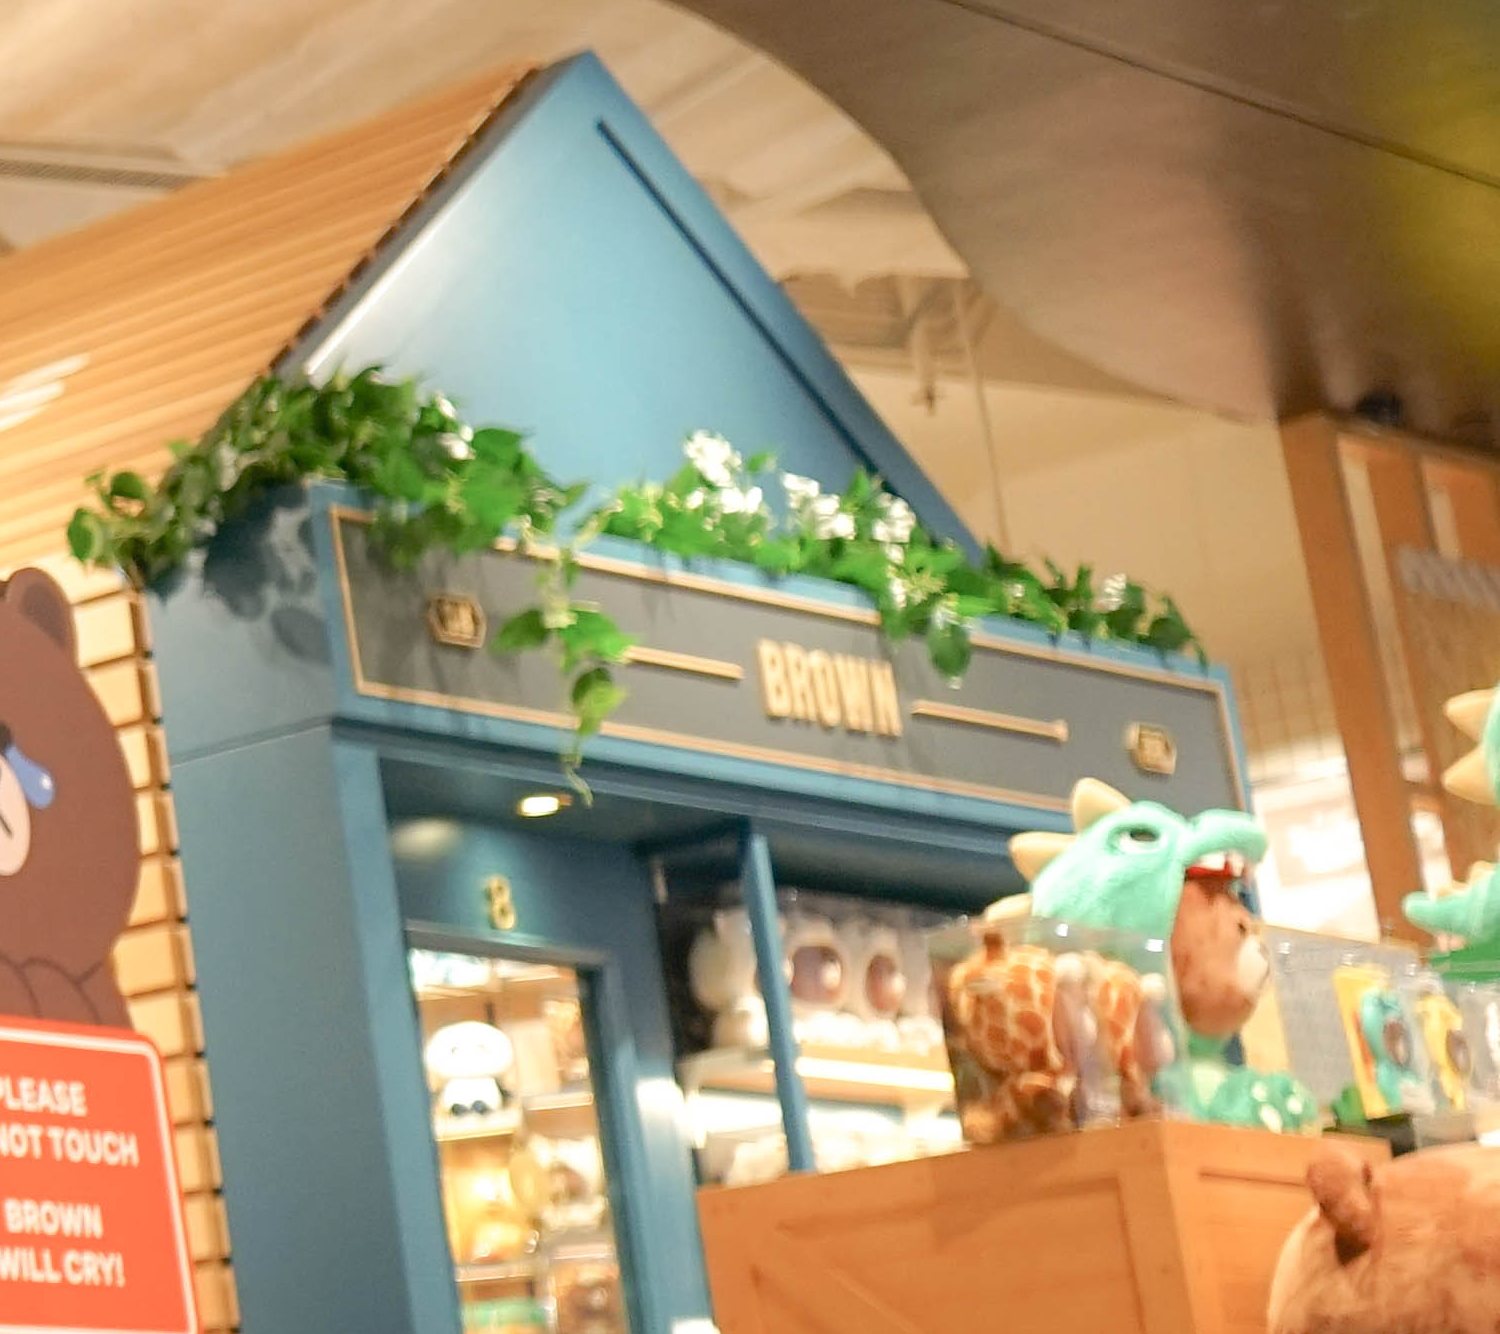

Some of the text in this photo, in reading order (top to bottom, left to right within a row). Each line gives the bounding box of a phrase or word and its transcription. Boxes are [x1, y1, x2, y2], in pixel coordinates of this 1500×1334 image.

[759, 639, 902, 737] BROWN
[47, 1125, 140, 1167] TOUCH
[4, 1198, 103, 1239] BROWN
[62, 1249, 126, 1287] CRY!
